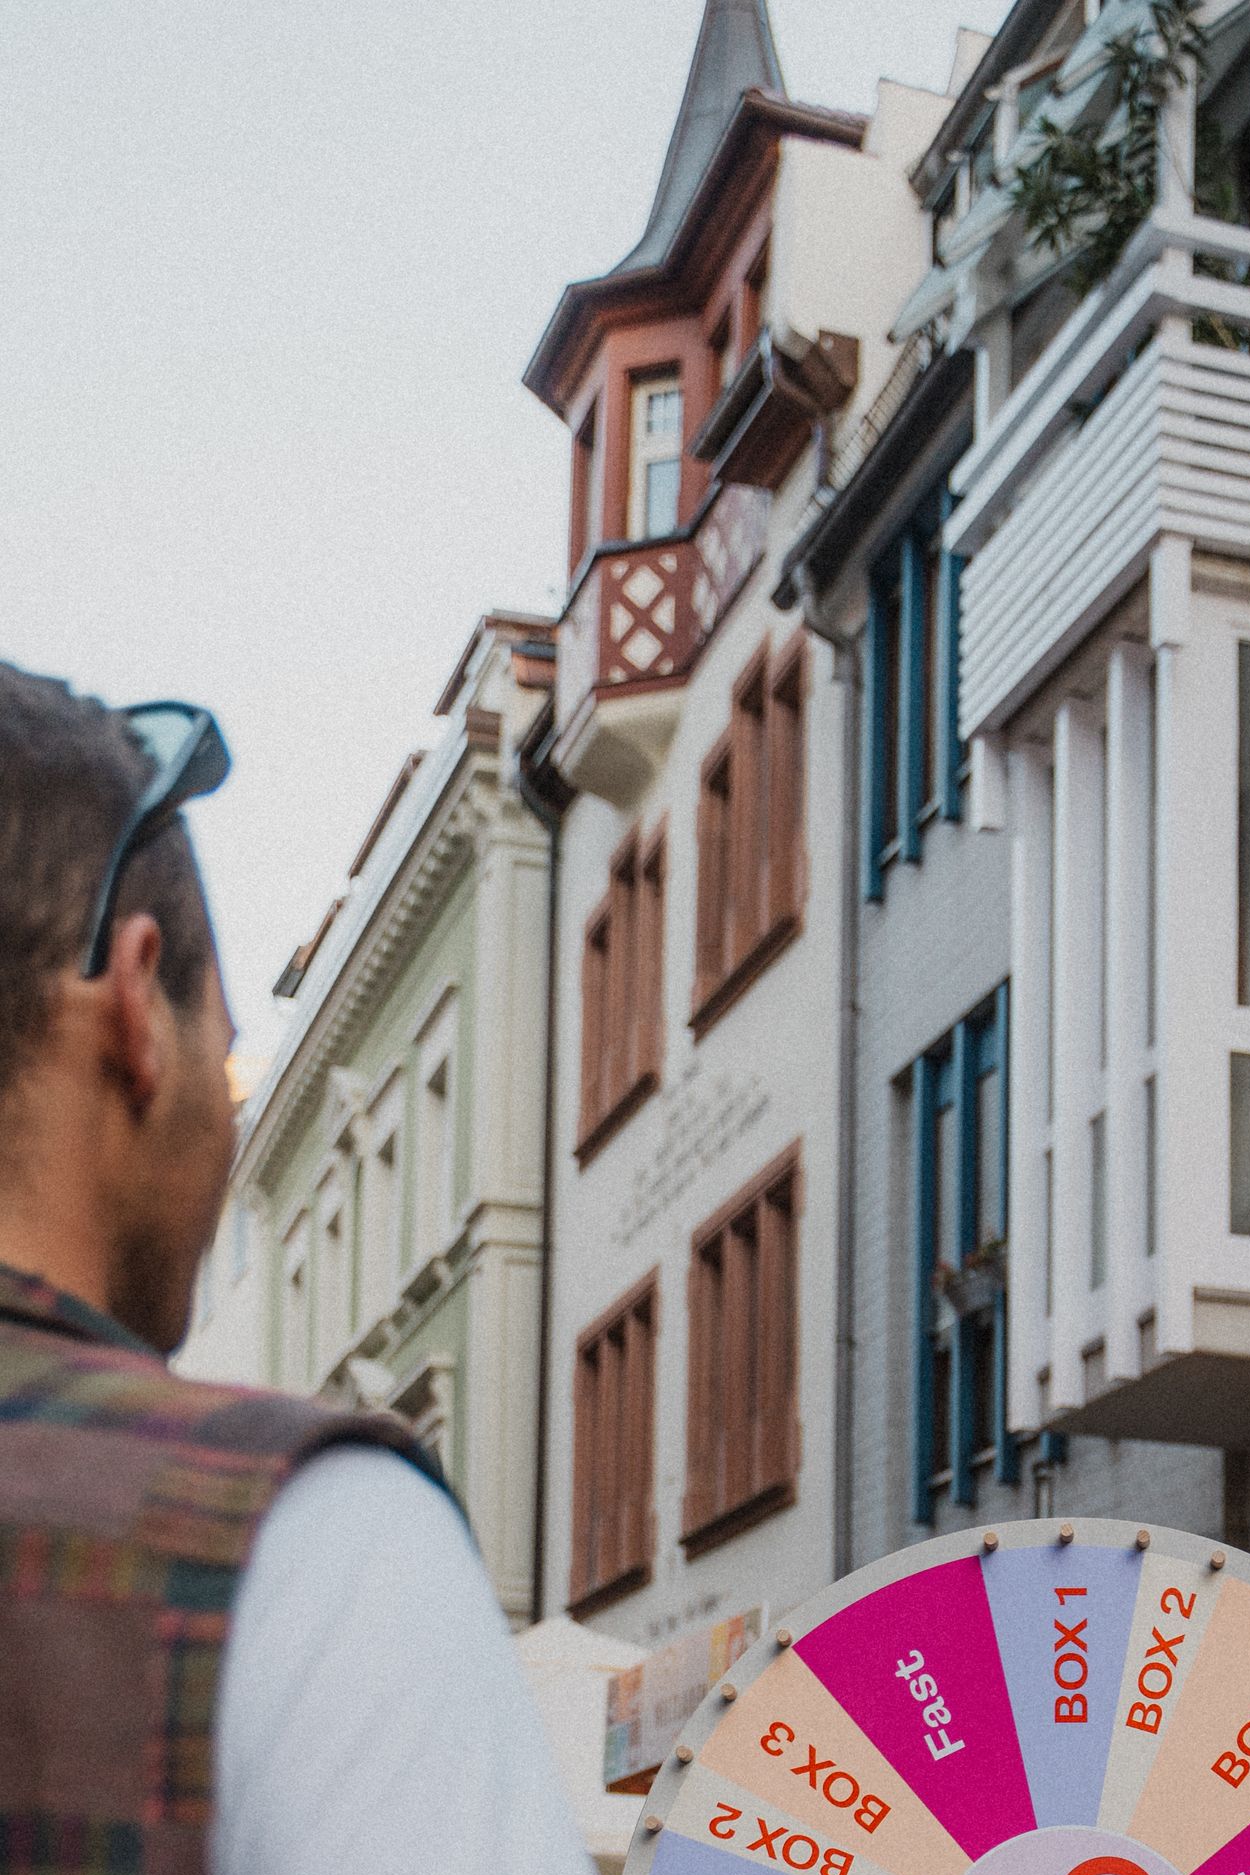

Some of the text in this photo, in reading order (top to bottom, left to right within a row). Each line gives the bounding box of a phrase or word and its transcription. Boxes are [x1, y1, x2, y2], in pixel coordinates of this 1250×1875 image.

[895, 1649, 966, 1761] Fast
[1053, 1588, 1087, 1722] BOX 1
[1126, 1588, 1195, 1734] BOX 2
[709, 1803, 741, 1839] 2
[760, 1721, 891, 1833] BOX 3
